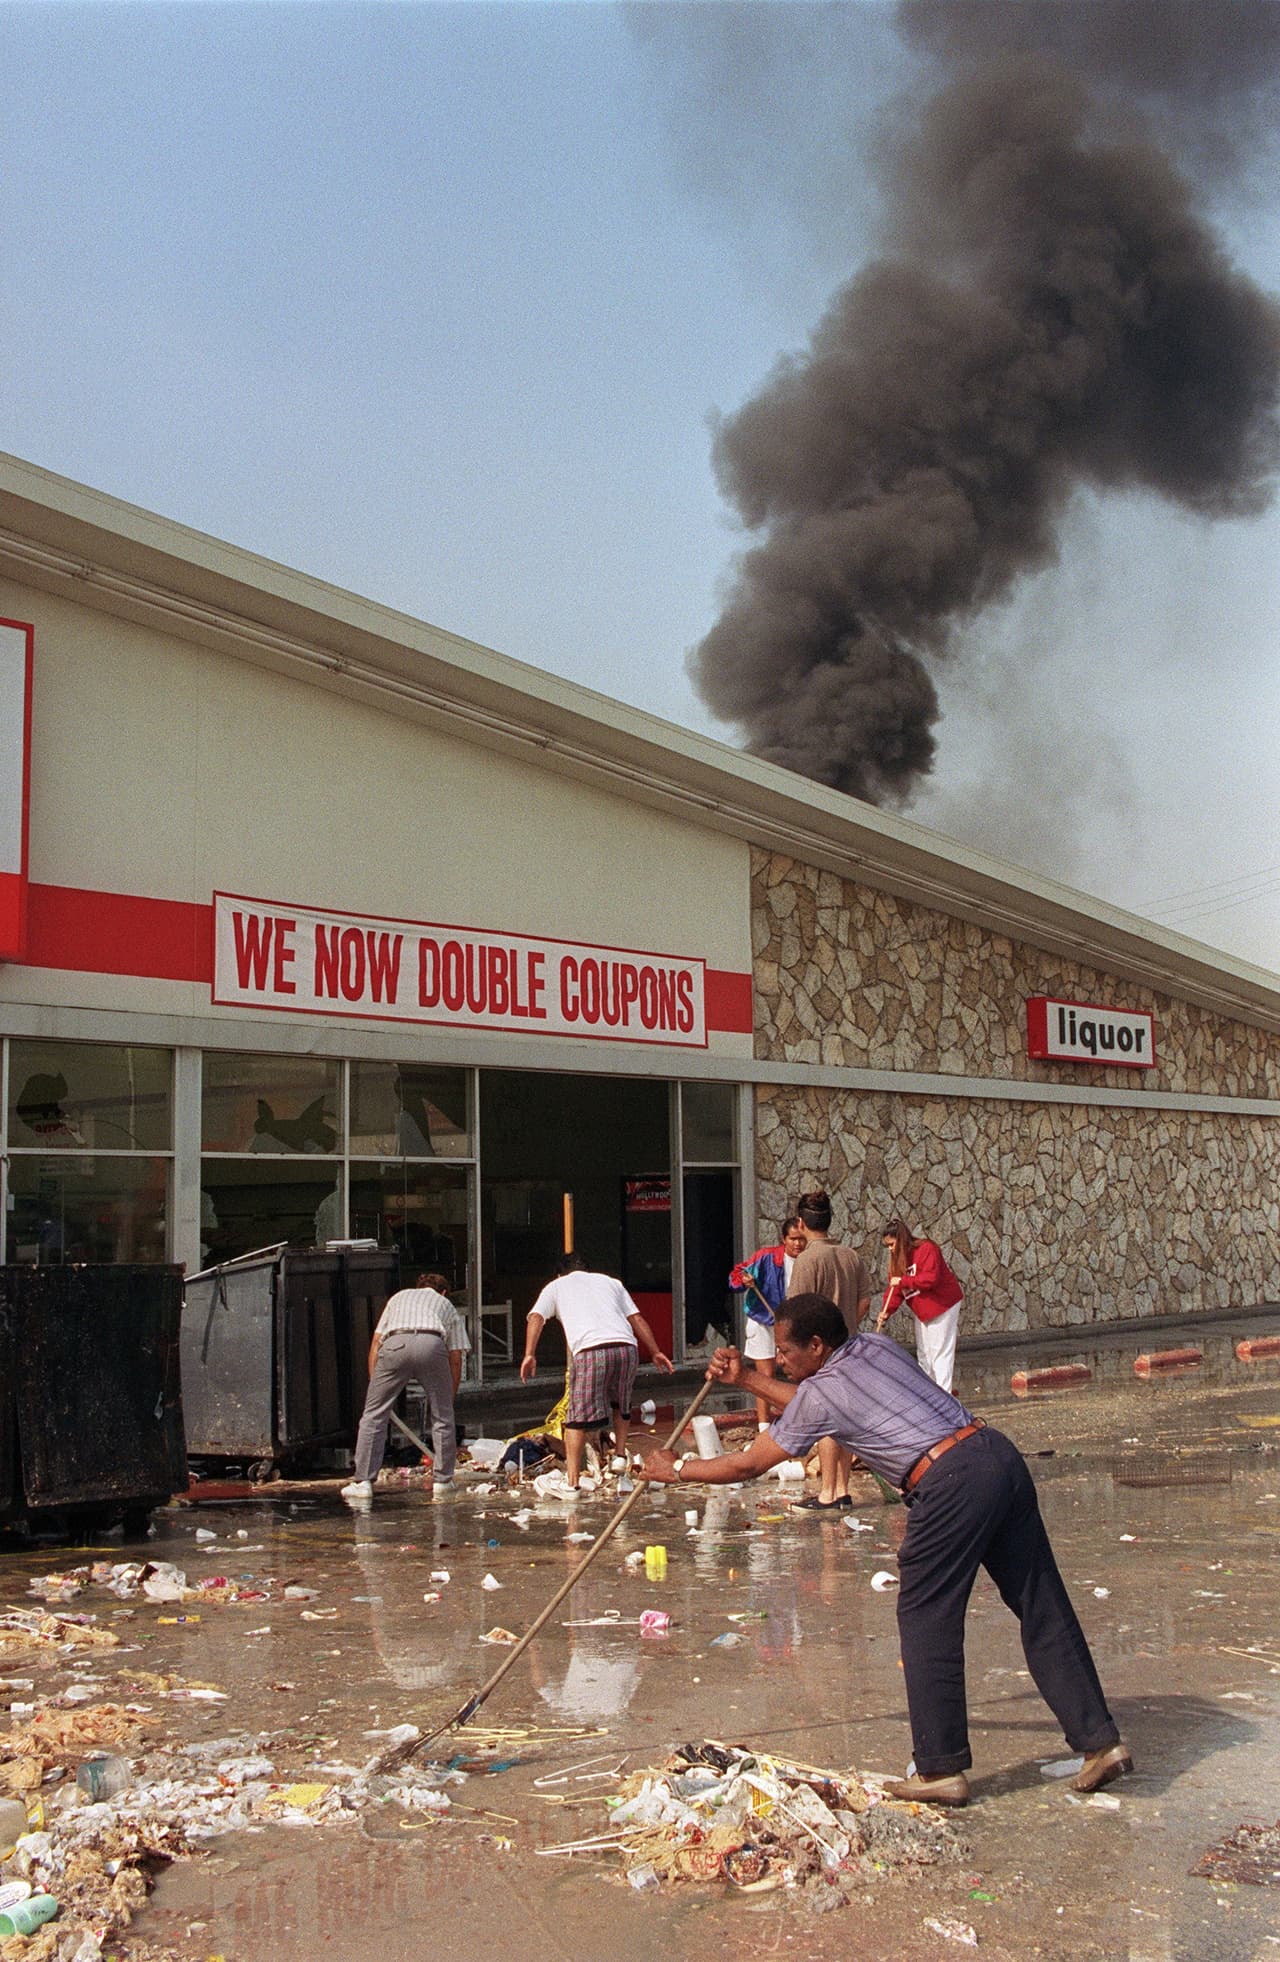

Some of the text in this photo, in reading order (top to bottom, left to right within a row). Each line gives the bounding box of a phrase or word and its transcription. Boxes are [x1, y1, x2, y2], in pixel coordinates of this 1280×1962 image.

[232, 911, 694, 1033] WE NOW DOUBLE COUPONS
[1058, 1007, 1145, 1056] liquor
